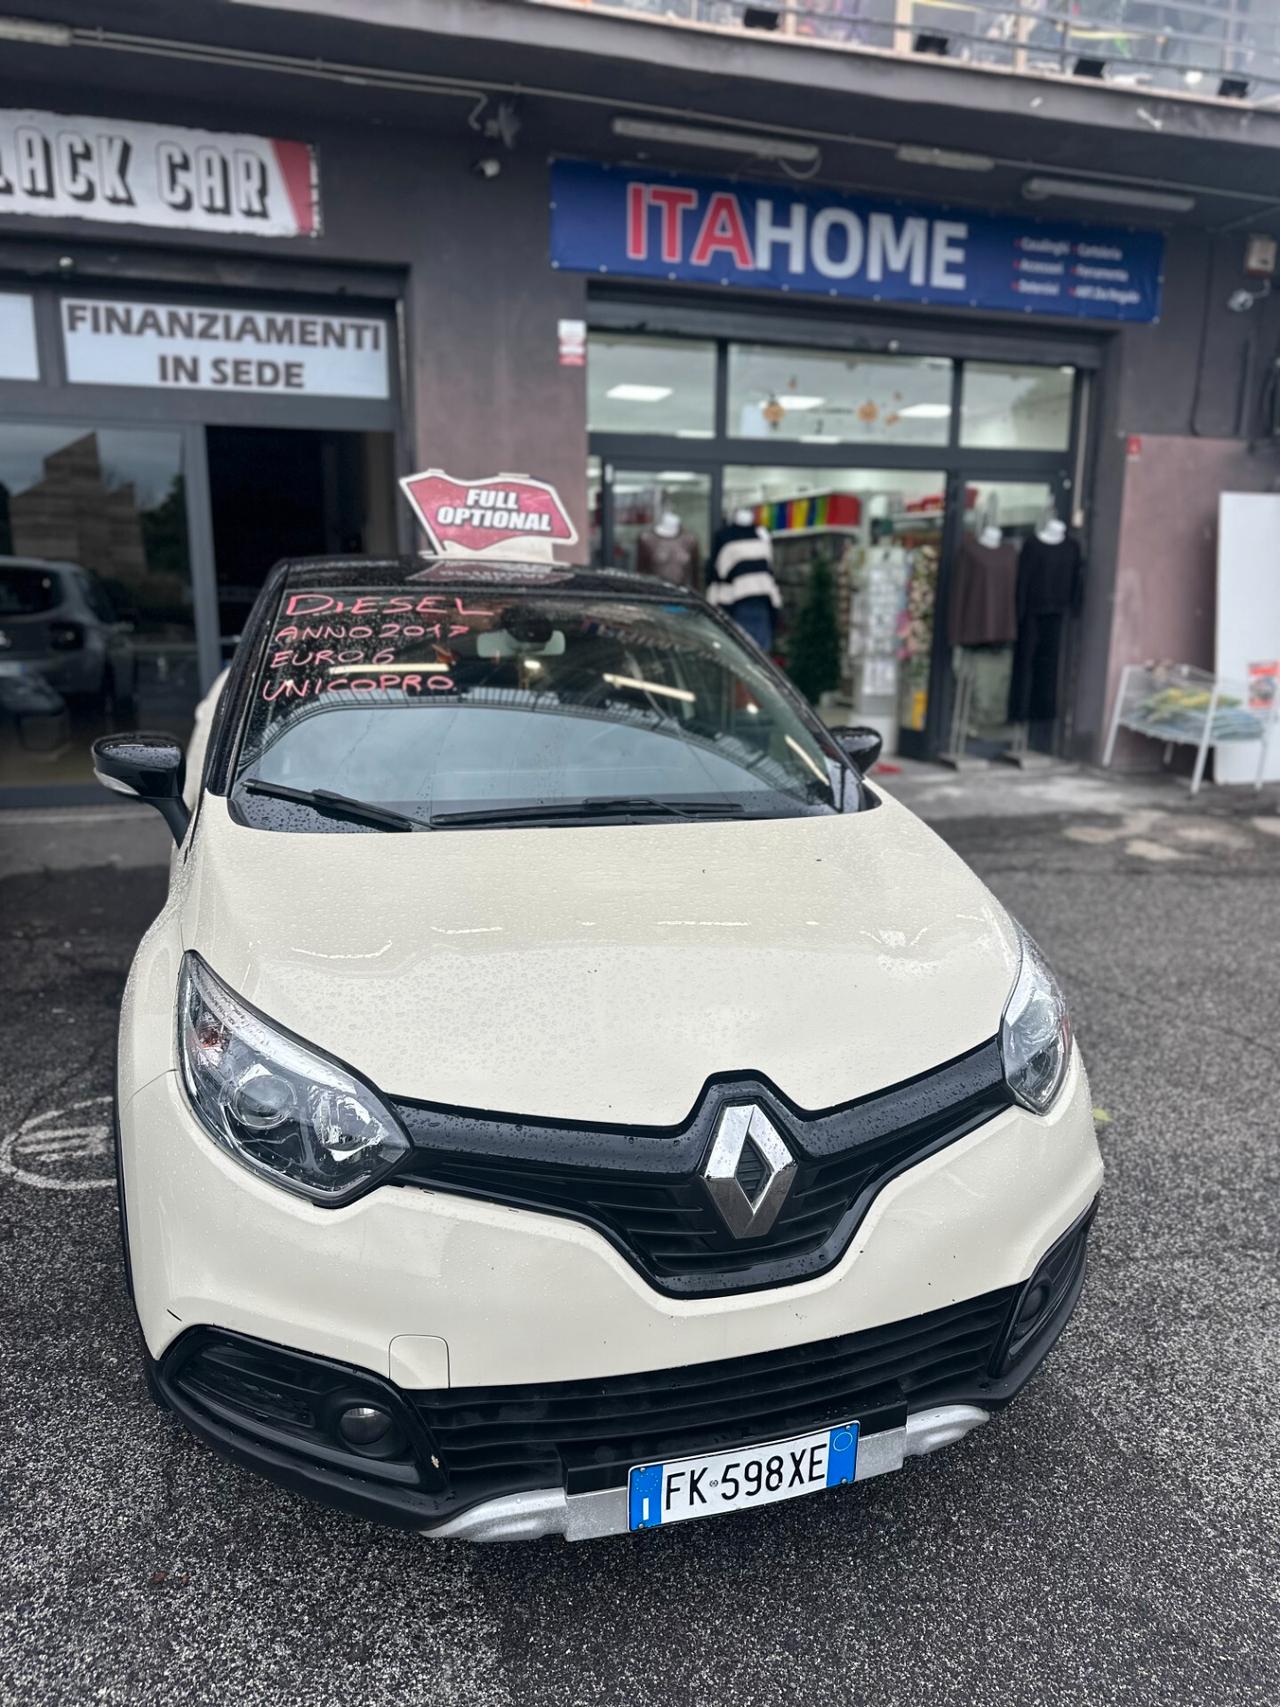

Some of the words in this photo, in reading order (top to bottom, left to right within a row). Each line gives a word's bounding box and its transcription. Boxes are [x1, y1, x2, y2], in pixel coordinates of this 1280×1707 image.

[0, 126, 136, 207] ACK
[156, 141, 269, 219] CAR
[626, 182, 969, 290] ITAHOME
[67, 304, 380, 351] FINANZIAMENTI
[159, 354, 199, 383] IN
[211, 357, 305, 389] SEDE
[466, 489, 518, 510] FULL
[437, 506, 551, 531] OPTIONAL
[275, 625, 373, 643] ANNO
[379, 623, 470, 639] 2017
[270, 649, 364, 669] EURO
[372, 647, 395, 665] 6
